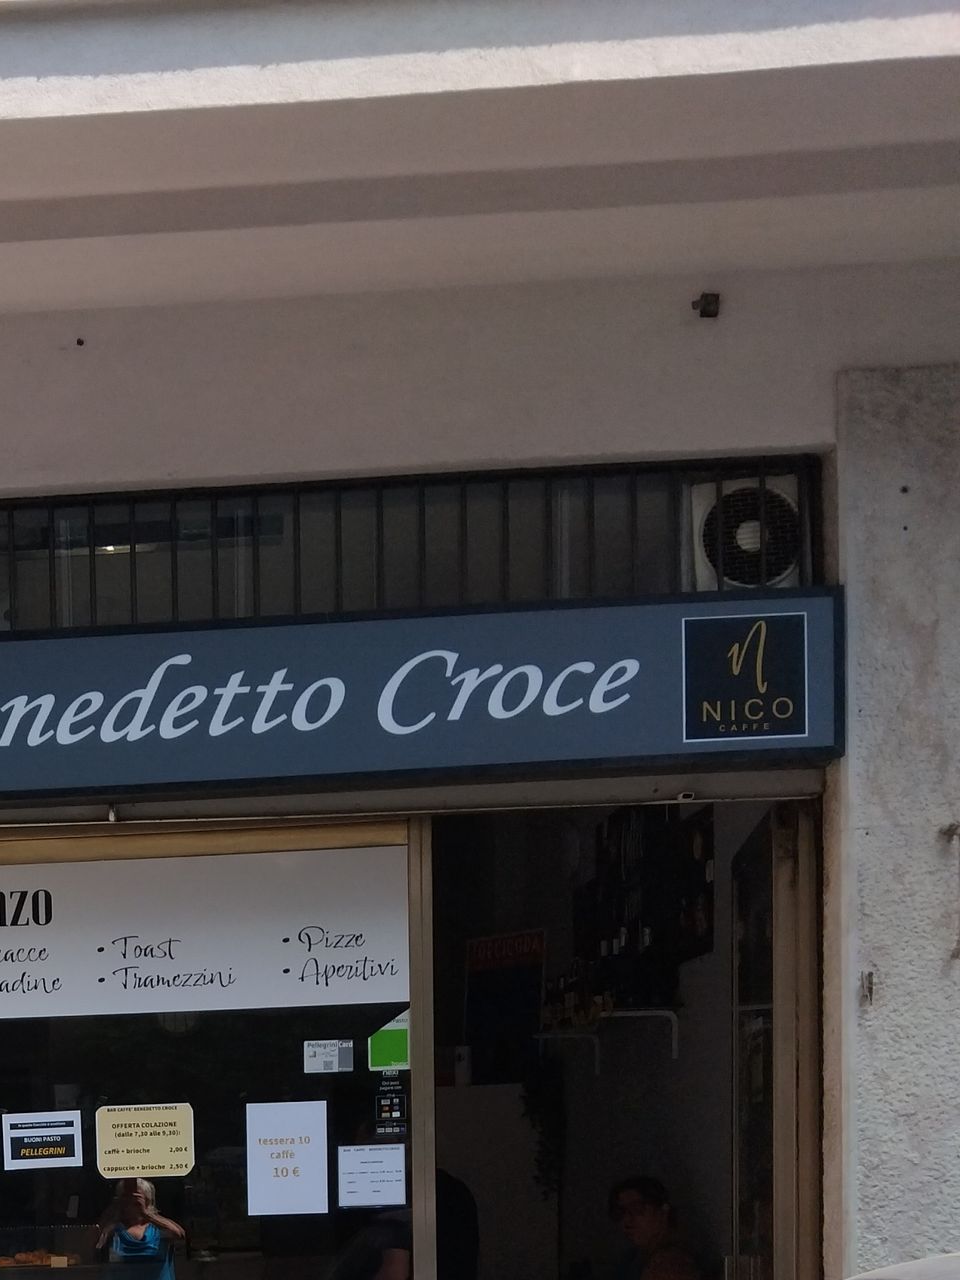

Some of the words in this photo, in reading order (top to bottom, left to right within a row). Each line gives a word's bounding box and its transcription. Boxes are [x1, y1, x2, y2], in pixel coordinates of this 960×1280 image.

[377, 649, 640, 735] Croce
[702, 697, 794, 722] NICO
[111, 936, 182, 960] Toast
[298, 925, 366, 952] Pizze
[112, 966, 237, 990] Tramezzini
[298, 956, 400, 987] Aperitivi
[20, 1147, 66, 1157] PELLEGRINI
[258, 1137, 295, 1146] tessera
[298, 1136, 310, 1144] 10
[273, 1167, 289, 1178] 10
[292, 1167, 300, 1177] €
